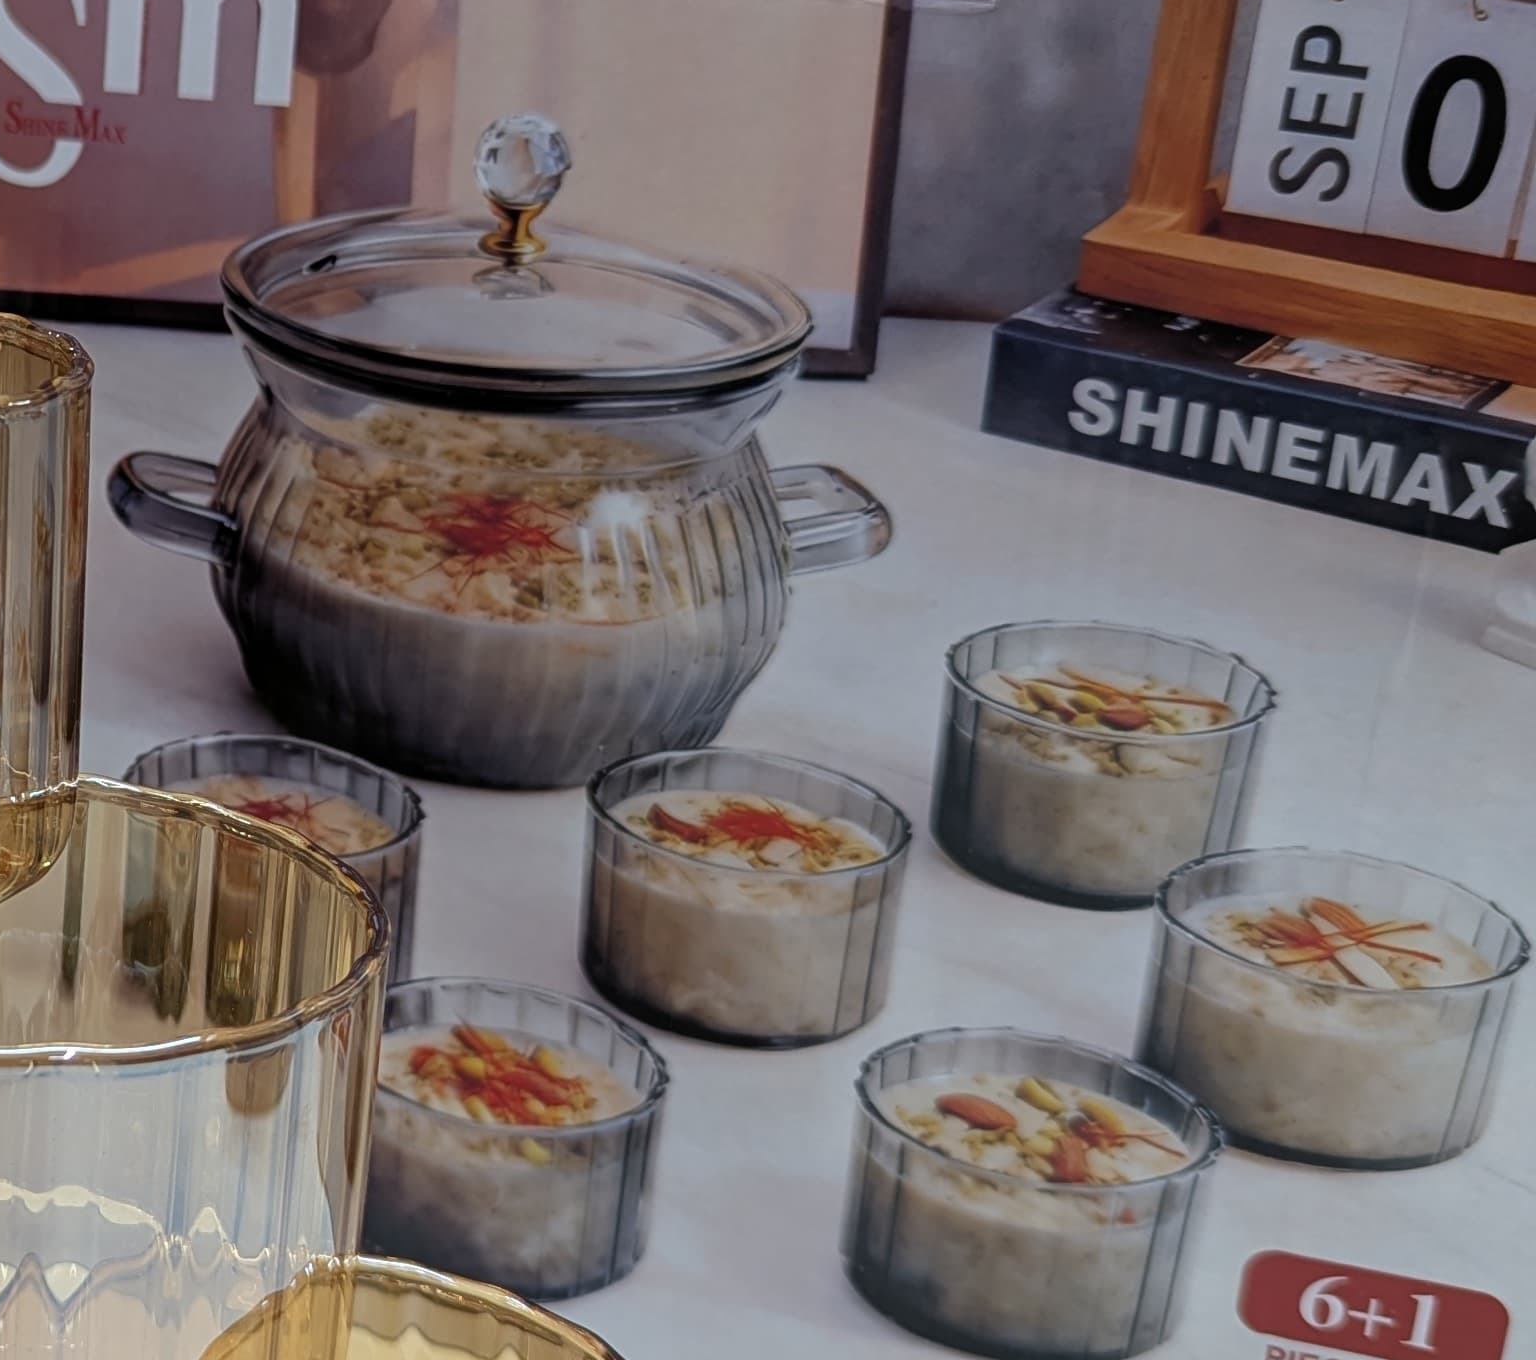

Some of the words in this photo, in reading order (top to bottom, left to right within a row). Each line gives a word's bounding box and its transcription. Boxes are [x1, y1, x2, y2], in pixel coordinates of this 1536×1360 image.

[1269, 24, 1370, 202] SEP
[1066, 378, 1518, 529] SHINEMAX
[1298, 1275, 1440, 1352] 6+1
